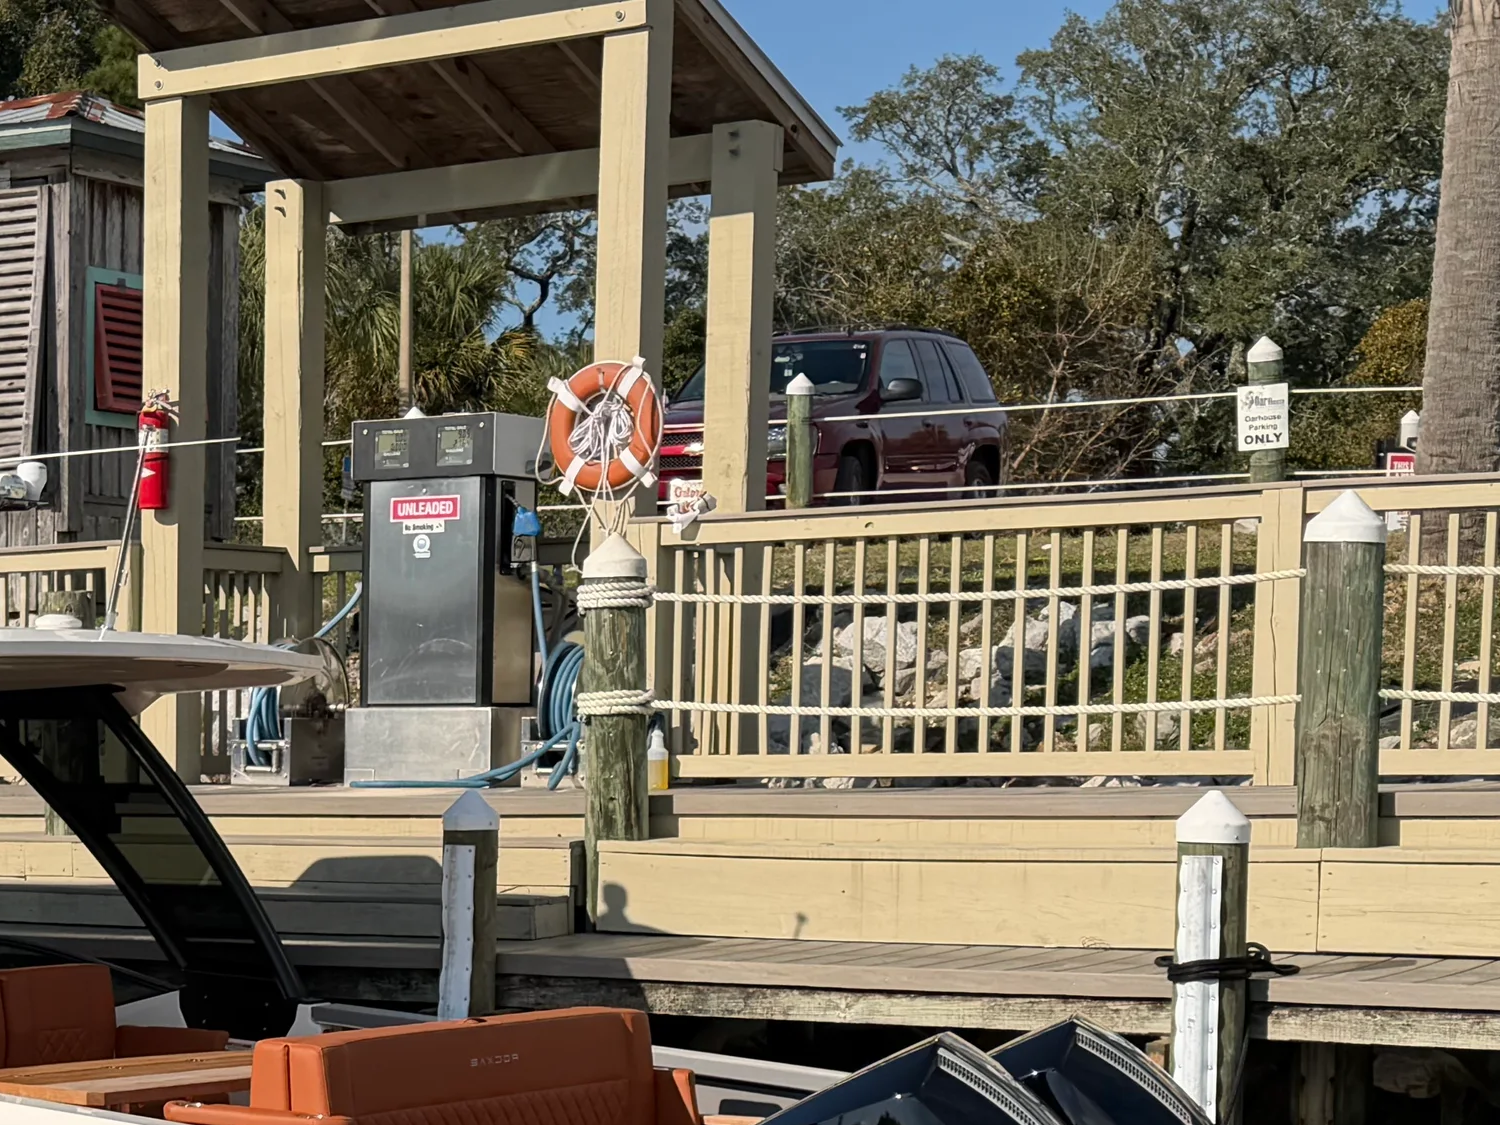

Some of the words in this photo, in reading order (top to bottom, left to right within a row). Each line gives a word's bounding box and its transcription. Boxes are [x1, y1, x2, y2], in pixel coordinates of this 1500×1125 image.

[1244, 414, 1282, 422] Oarhouse
[1248, 423, 1278, 431] Parking
[1244, 432, 1283, 445] ONLY
[397, 500, 454, 517] UNLEADED
[412, 522, 434, 532] Smoking
